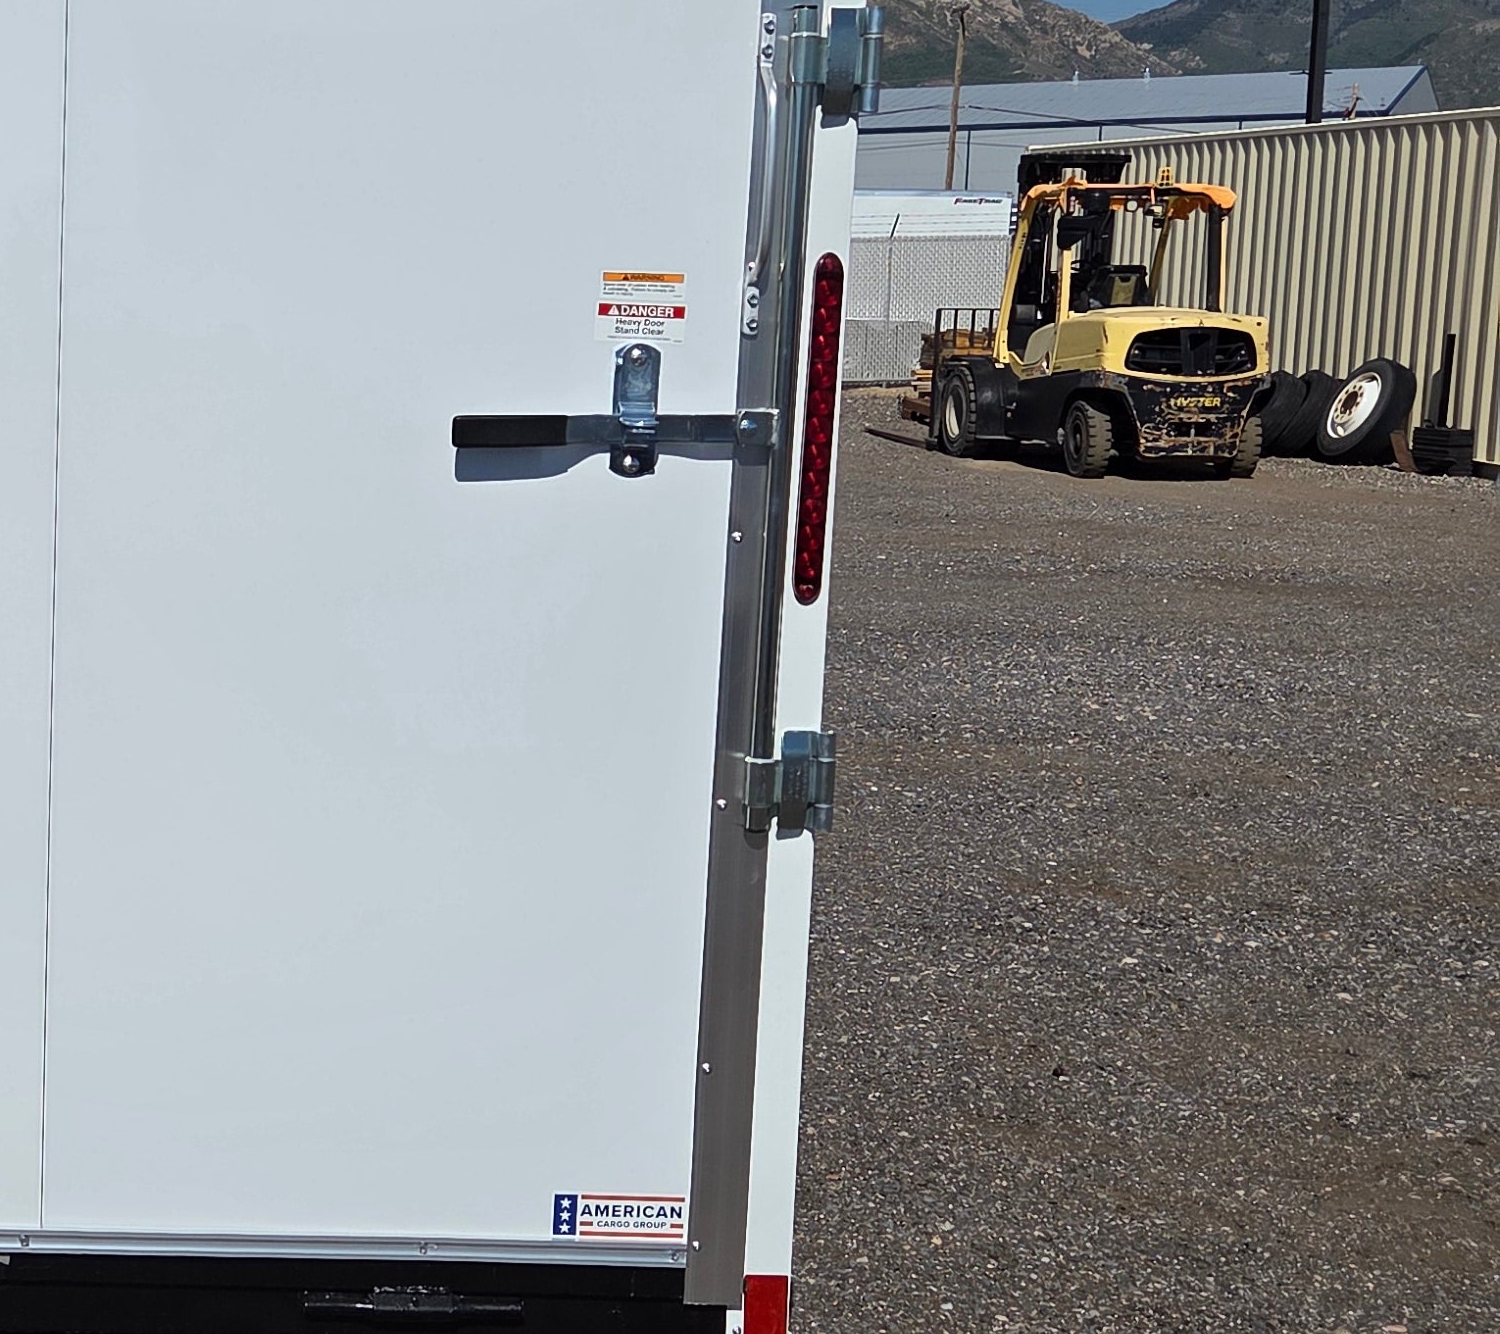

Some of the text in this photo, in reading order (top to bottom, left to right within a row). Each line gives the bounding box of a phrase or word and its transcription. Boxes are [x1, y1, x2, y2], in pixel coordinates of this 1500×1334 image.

[620, 305, 675, 318] DANGER
[615, 317, 665, 328] Heavy Door
[614, 326, 665, 336] Stand Clear
[580, 1204, 683, 1219] AMERICAN
[596, 1220, 667, 1229] CARGO GROUP
